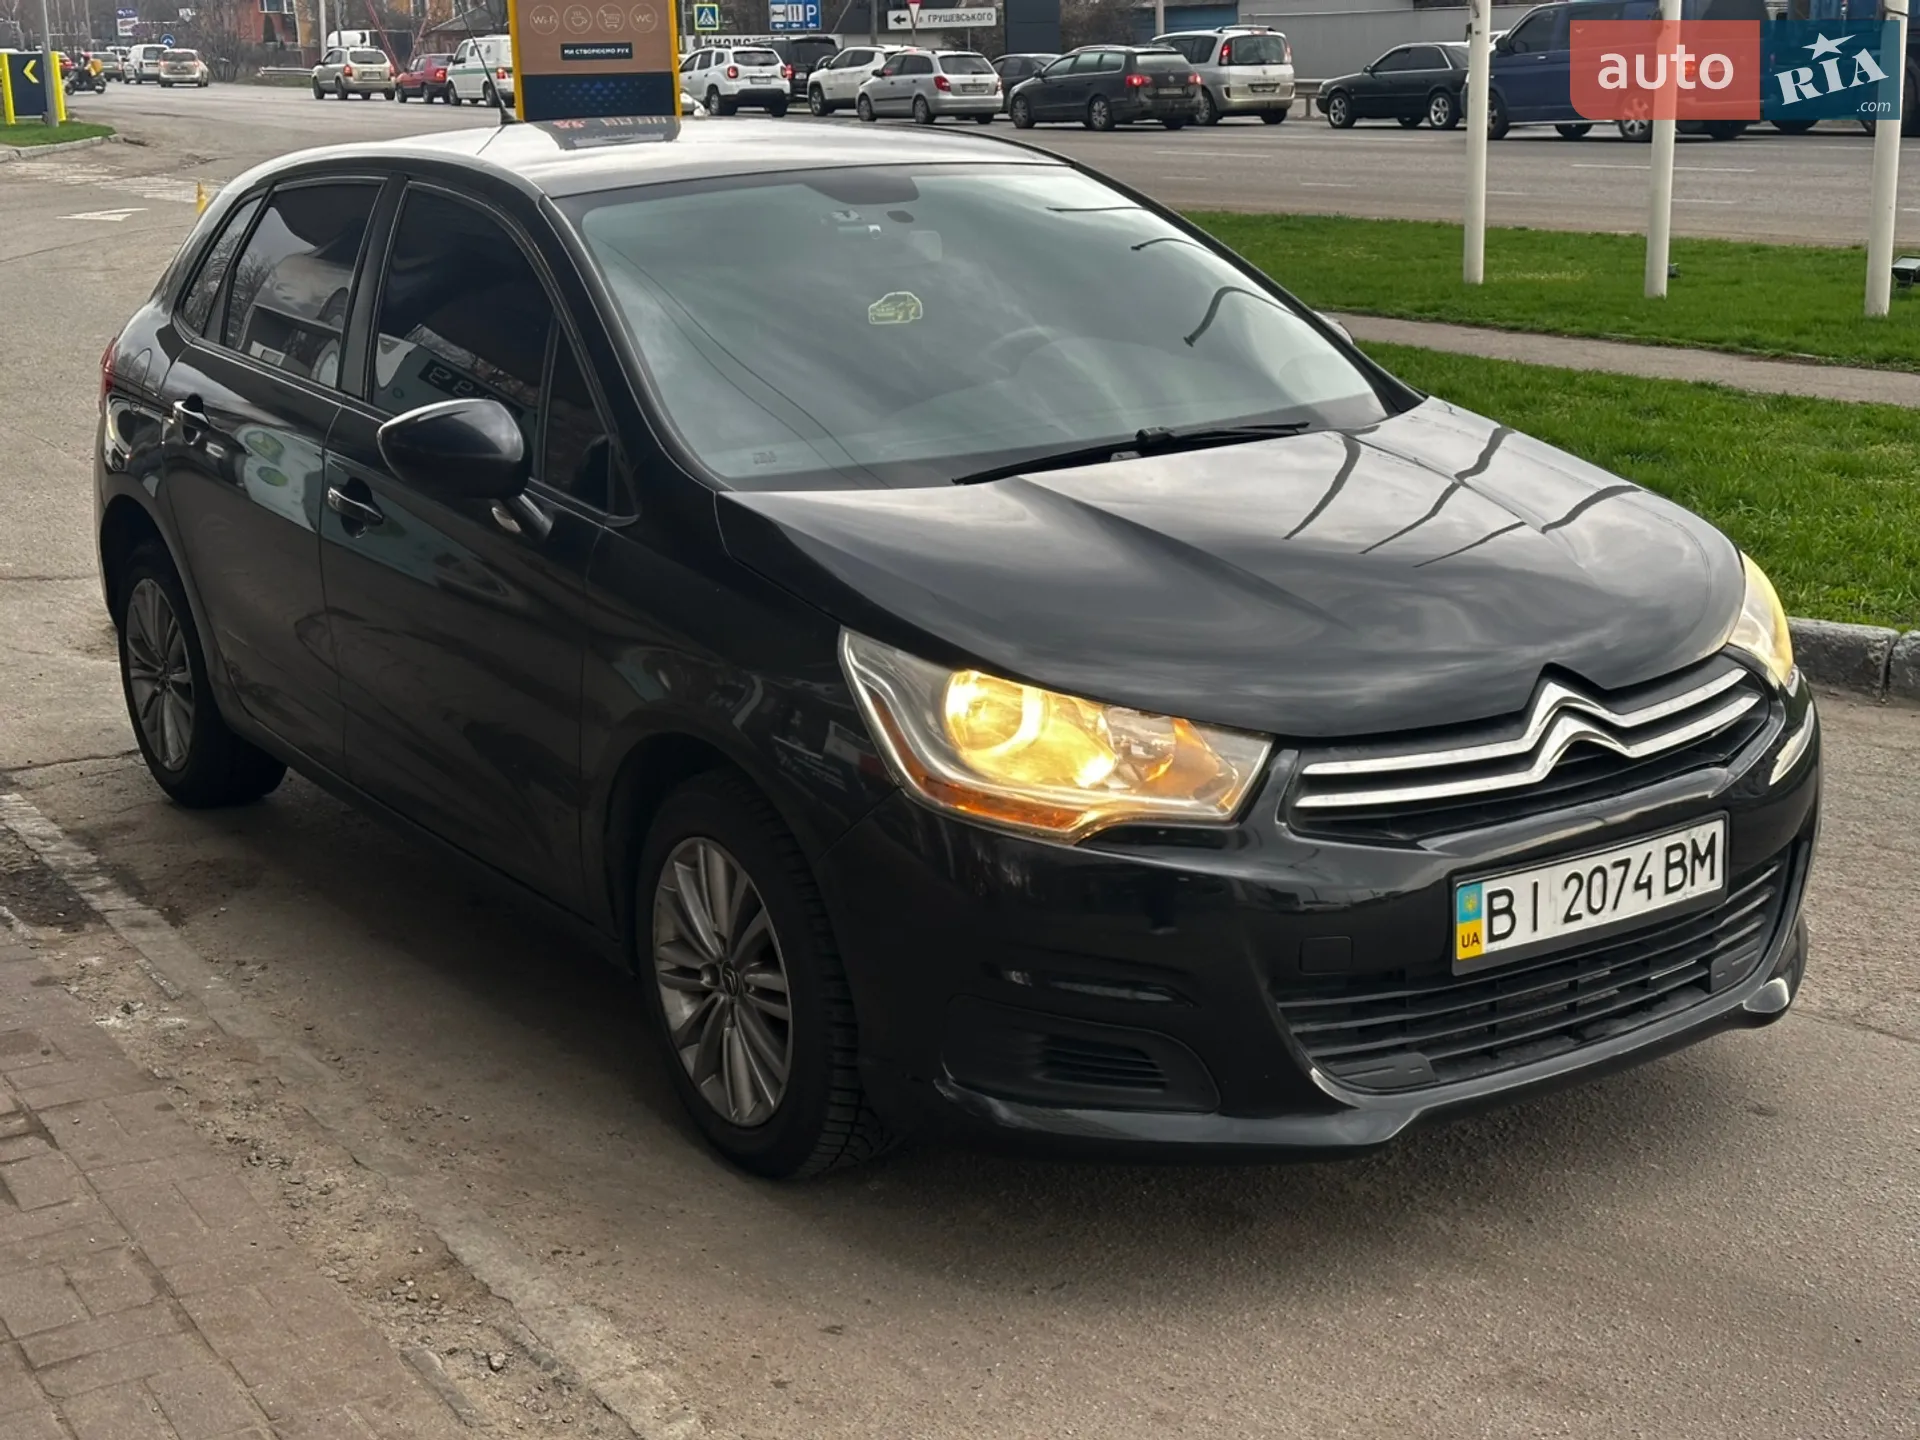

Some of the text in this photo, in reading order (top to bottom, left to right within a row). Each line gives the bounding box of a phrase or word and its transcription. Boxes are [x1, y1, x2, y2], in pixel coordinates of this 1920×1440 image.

[634, 13, 652, 23] WC
[928, 12, 993, 23] ГРУШЕВСЬКОГО
[1563, 851, 1653, 924] 2074
[1461, 935, 1480, 949] UA
